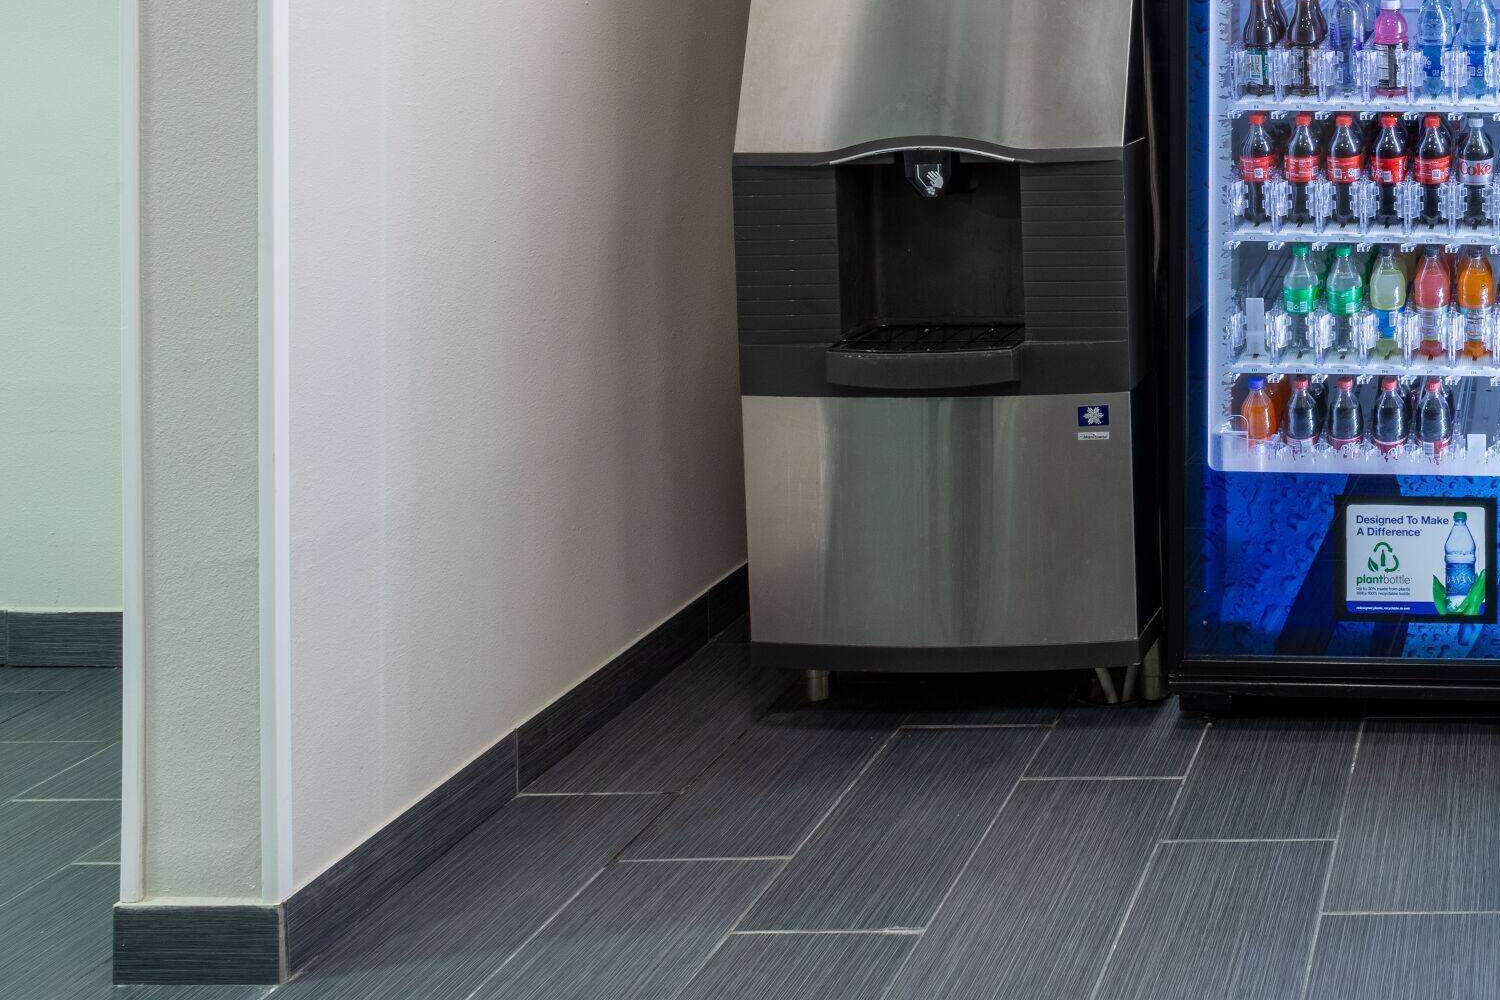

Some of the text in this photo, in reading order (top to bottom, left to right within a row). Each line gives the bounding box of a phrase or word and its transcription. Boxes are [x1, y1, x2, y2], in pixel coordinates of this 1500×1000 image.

[1460, 161, 1492, 177] Coke
[1356, 515, 1449, 526] Designed To Make
[1356, 527, 1365, 536] A
[1356, 574, 1412, 586] plantbottle
